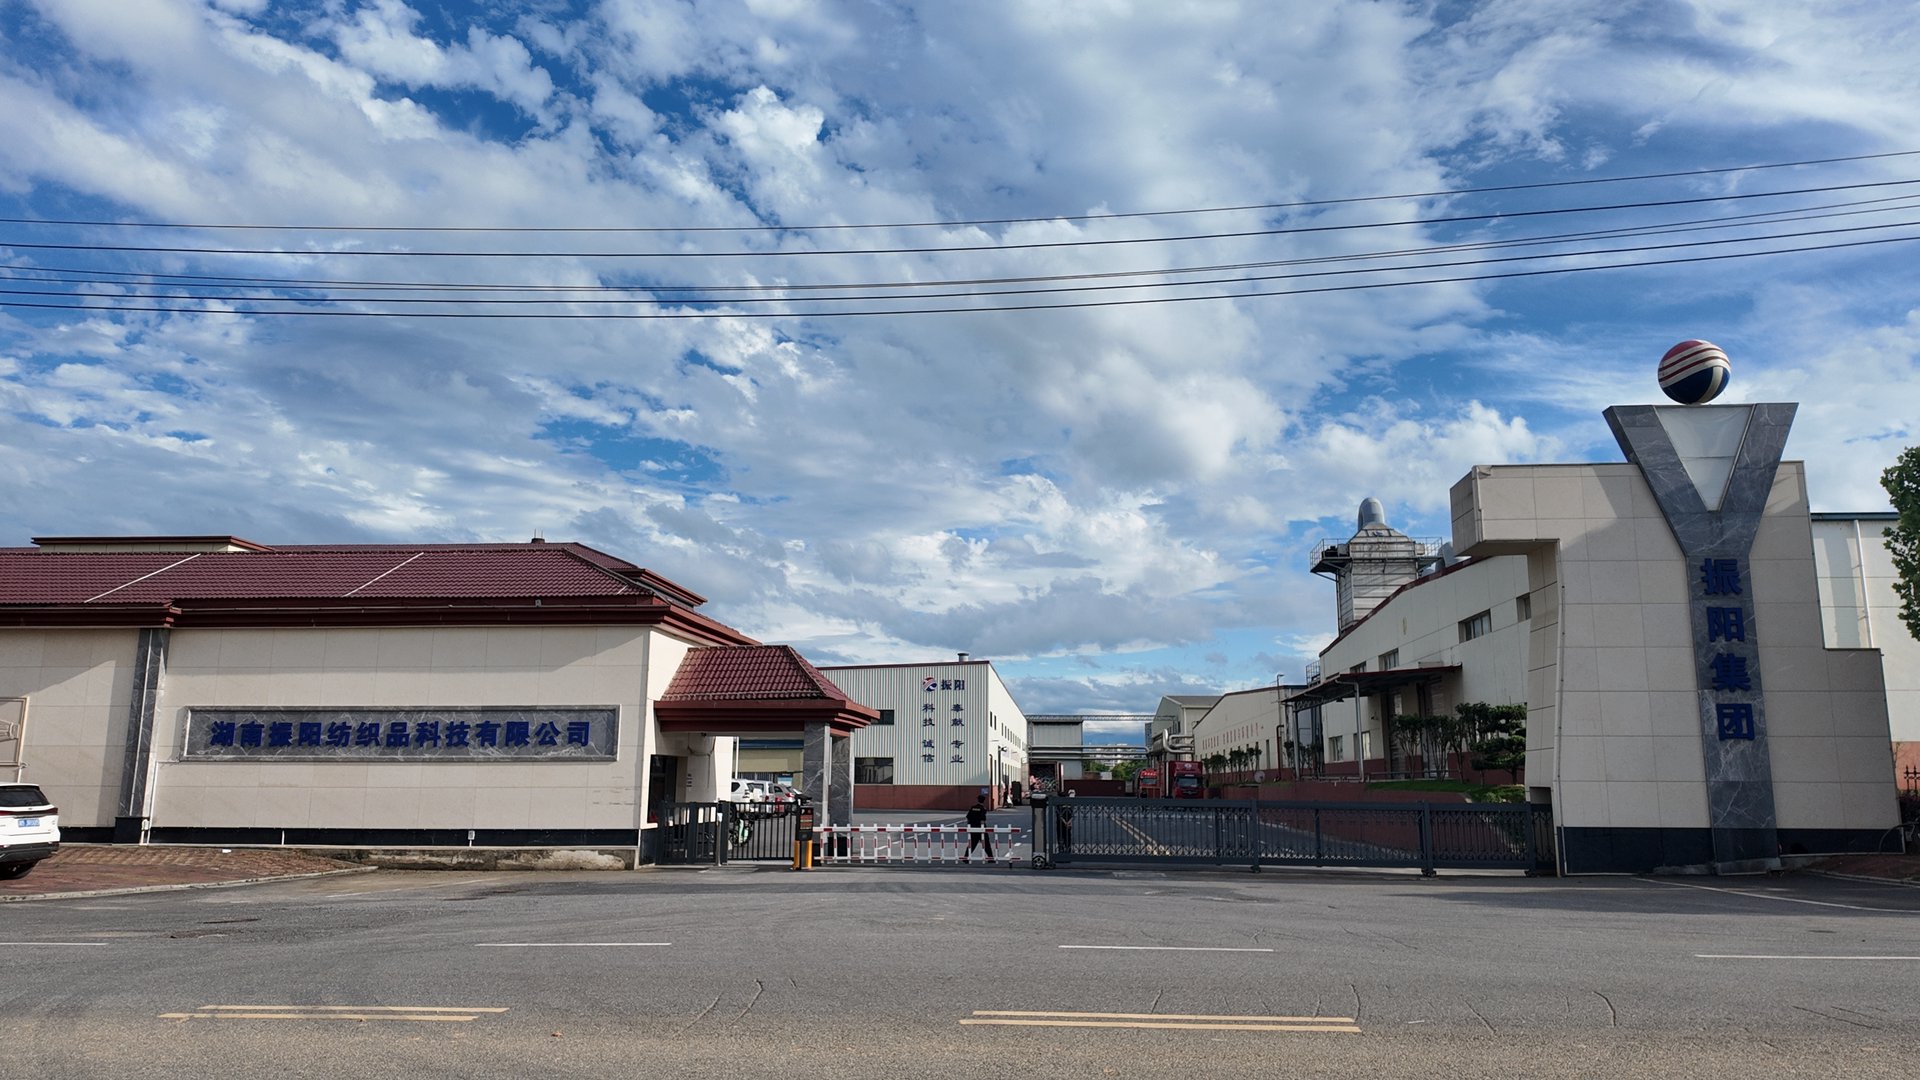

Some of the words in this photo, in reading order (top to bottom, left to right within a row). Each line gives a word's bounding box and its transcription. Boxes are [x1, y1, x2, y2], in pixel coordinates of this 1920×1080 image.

[1700, 557, 1755, 742] 振阳集团
[941, 679, 965, 690] 振阳
[210, 720, 591, 748] 湖南振阳纺织品科技有限公司
